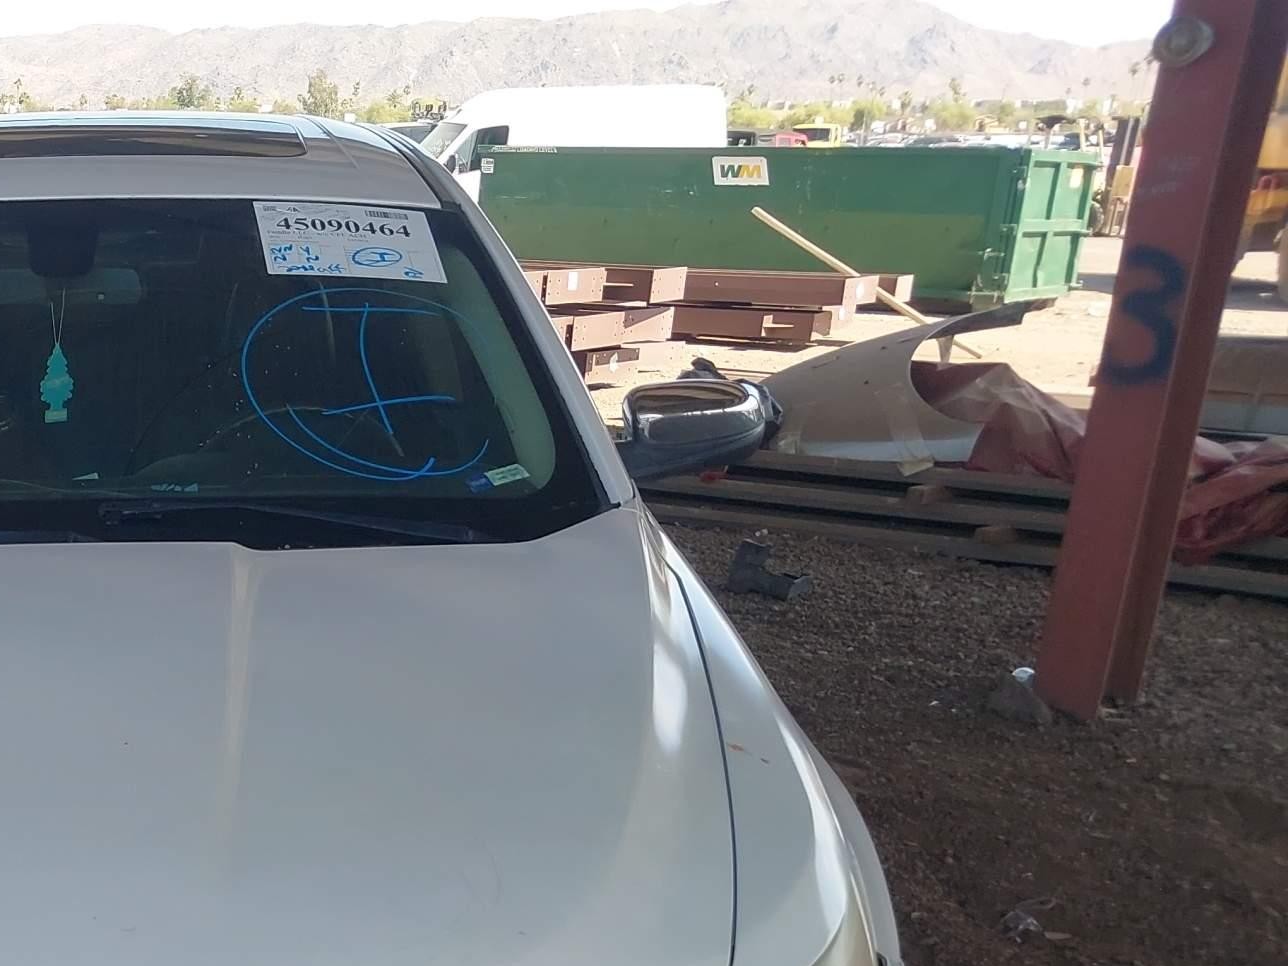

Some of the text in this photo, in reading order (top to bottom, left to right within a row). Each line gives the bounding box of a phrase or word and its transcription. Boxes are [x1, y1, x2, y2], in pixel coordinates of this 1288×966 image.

[719, 164, 762, 179] WM
[275, 216, 412, 240] 45090464
[1102, 243, 1186, 385] 3
